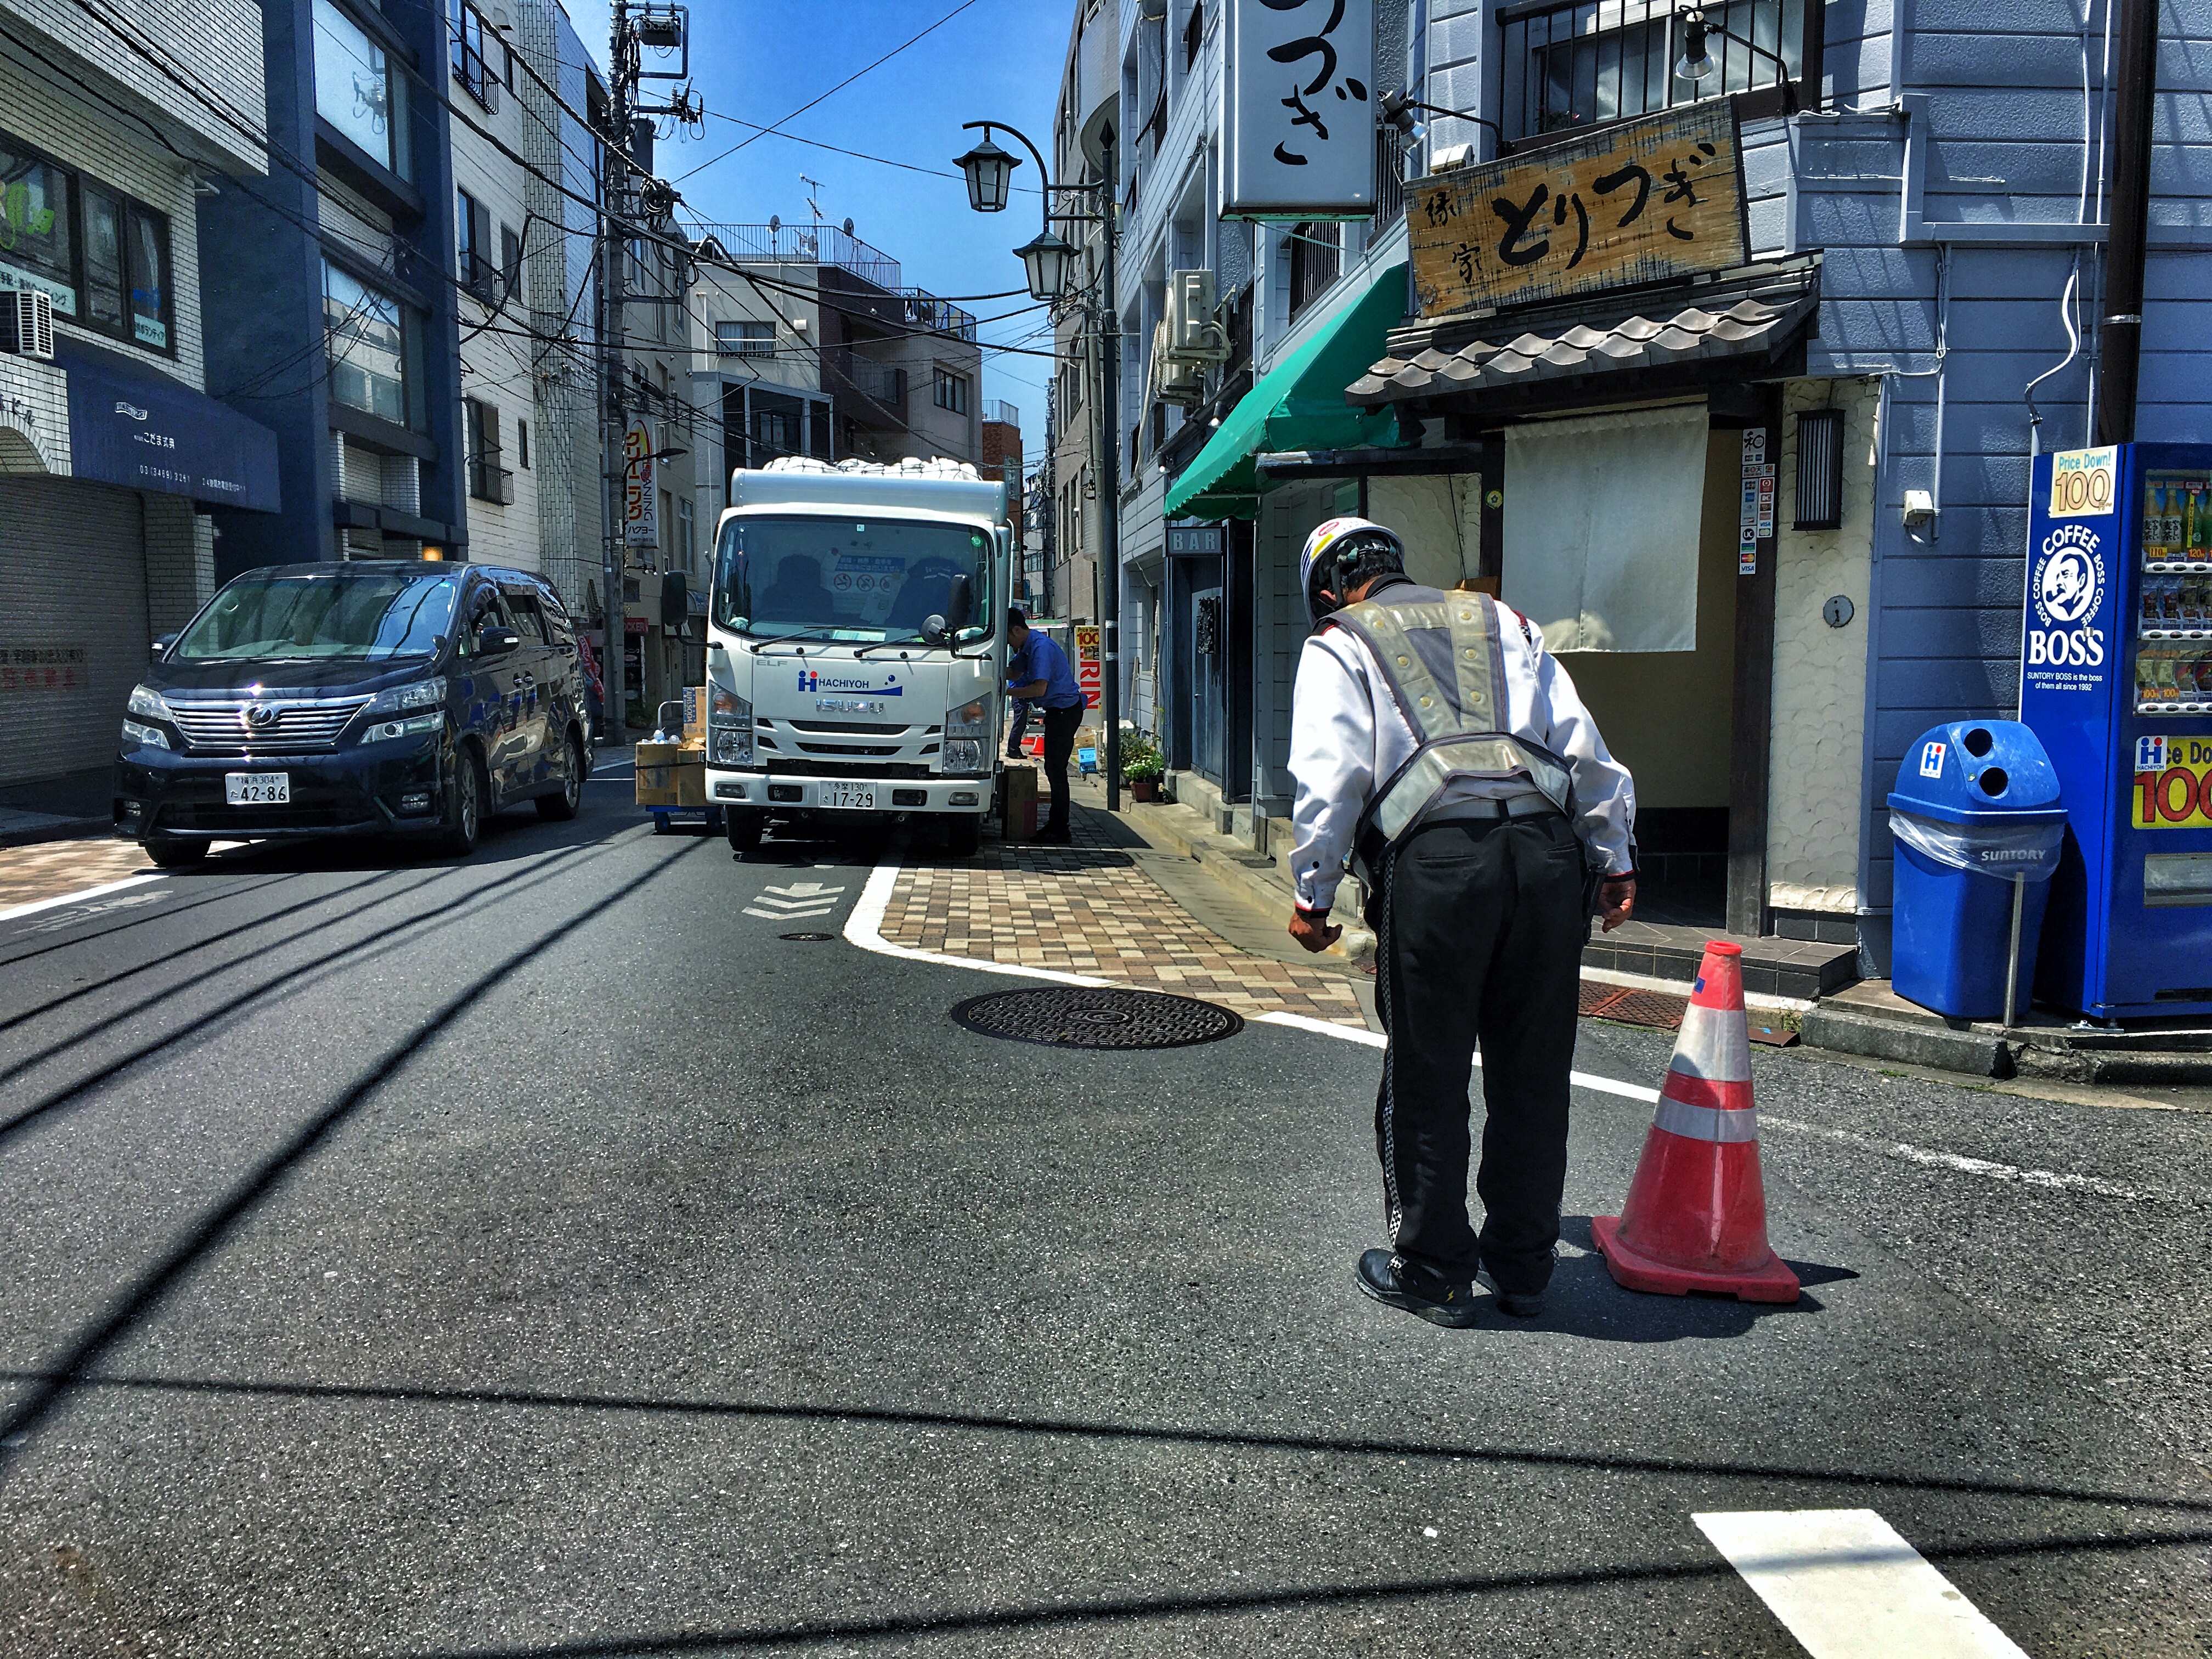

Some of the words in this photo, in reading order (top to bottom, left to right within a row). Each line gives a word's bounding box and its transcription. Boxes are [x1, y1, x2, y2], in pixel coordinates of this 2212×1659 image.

[1260, 0, 1367, 165] つぎ
[1492, 143, 1716, 270] とりつぎ
[2059, 456, 2080, 471] Price
[2084, 451, 2111, 469] Down!
[627, 432, 642, 520] クリーニング
[1173, 532, 1215, 550] BAR
[2042, 525, 2101, 555] COFFEE
[2033, 557, 2046, 600] COFFEE
[2094, 554, 2105, 584] BOSS
[2035, 601, 2052, 627] BOSS
[2081, 588, 2104, 627] COFFEE
[624, 622, 644, 631] OCKER
[2028, 630, 2103, 666] BOSS
[819, 678, 869, 689] HACHIYOH
[2027, 672, 2055, 680] SUNTORY
[816, 698, 883, 714] ISUZU
[241, 786, 286, 801] 42-86
[833, 792, 873, 807] 17-29
[1981, 849, 2046, 861] SUNTORY
